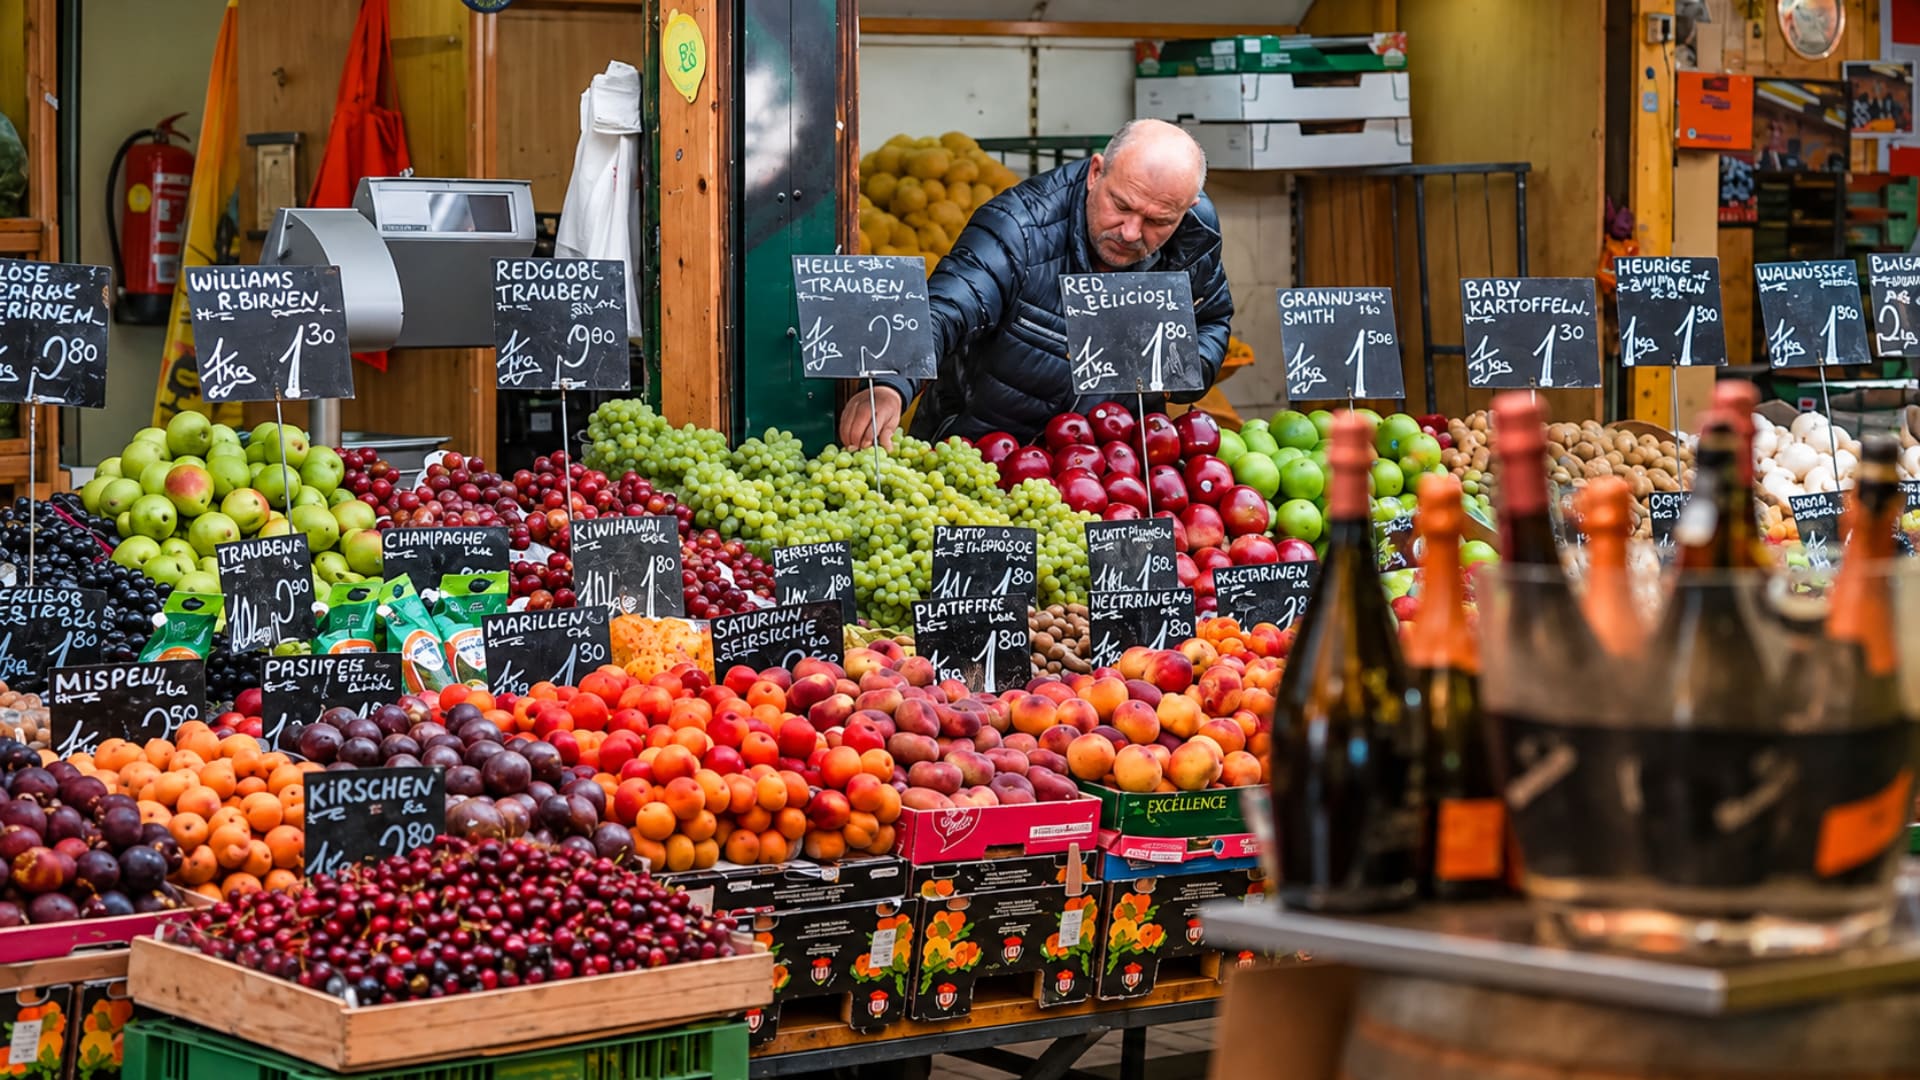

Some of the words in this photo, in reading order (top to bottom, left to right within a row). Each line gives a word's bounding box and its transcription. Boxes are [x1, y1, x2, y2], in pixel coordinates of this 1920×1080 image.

[496, 260, 604, 281] REDGLOBE
[796, 257, 856, 274] HELLE
[496, 282, 599, 303] TRAUBEN
[801, 272, 905, 294] TRAUBEN
[1465, 280, 1521, 299] BABY
[1283, 308, 1335, 326] SMITH
[1147, 796, 1227, 814] EXCELLENCE
